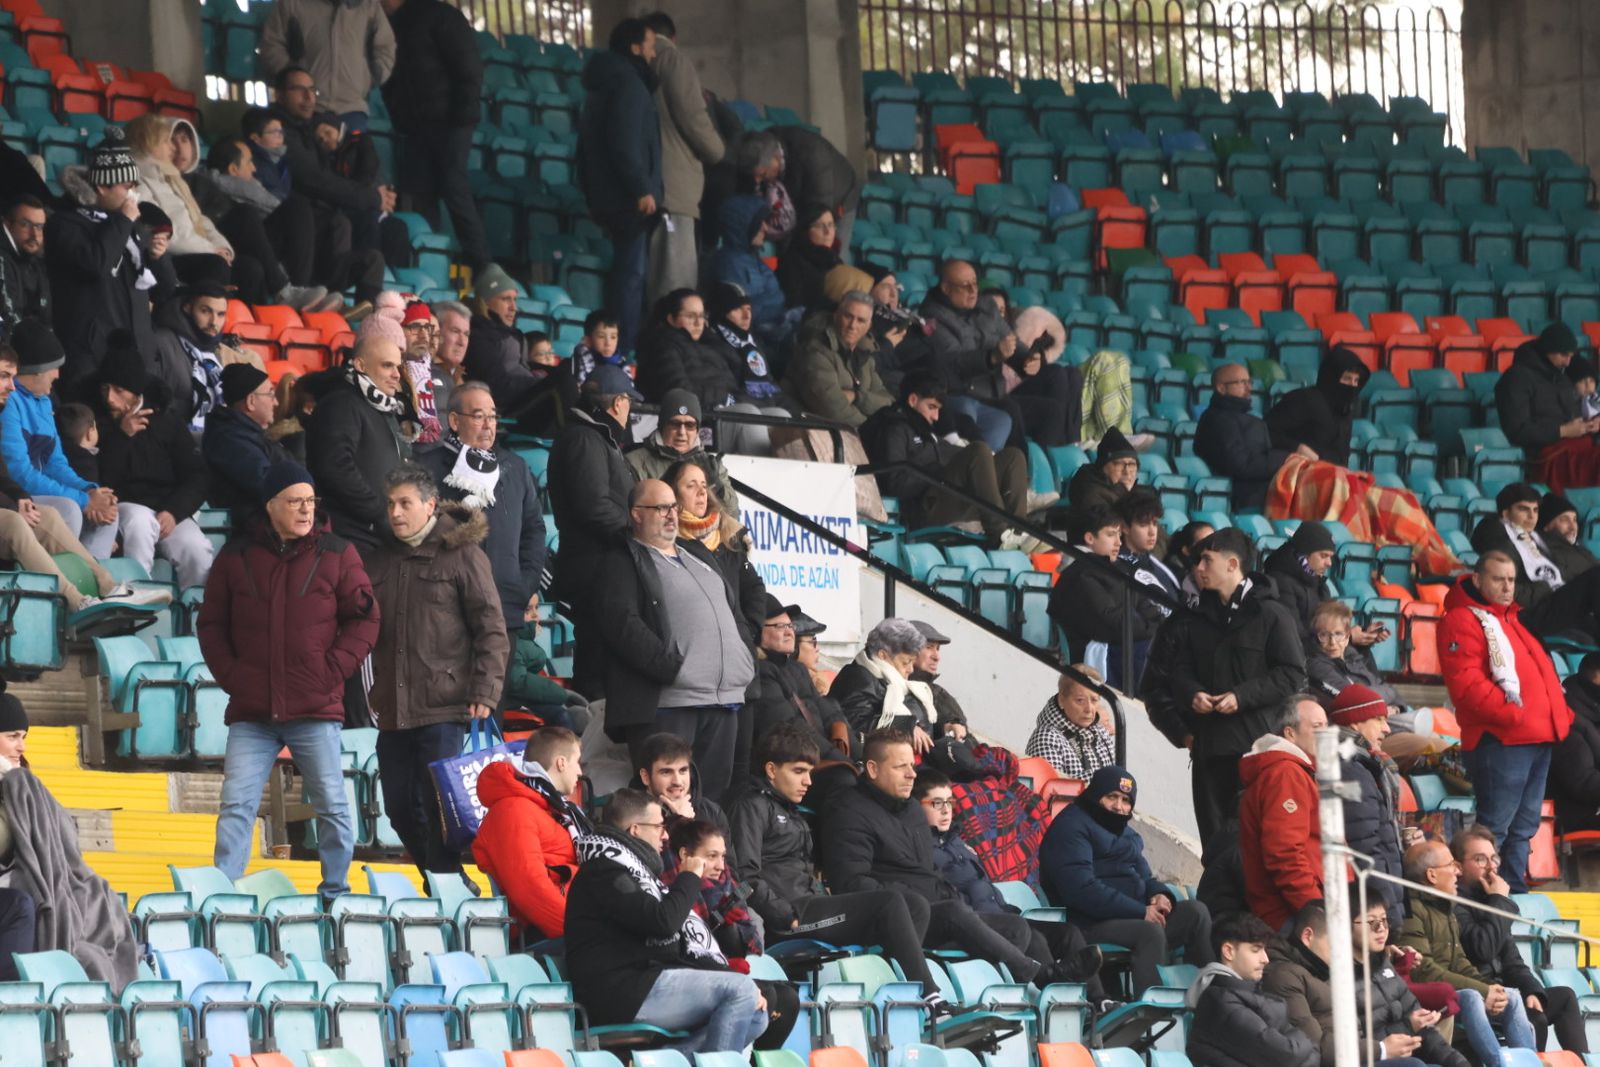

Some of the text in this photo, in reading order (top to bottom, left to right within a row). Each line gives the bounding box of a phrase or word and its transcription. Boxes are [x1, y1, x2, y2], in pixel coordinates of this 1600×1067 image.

[739, 510, 852, 557] NIMARKET
[790, 565, 806, 586] DE
[809, 562, 839, 589] AZÁN
